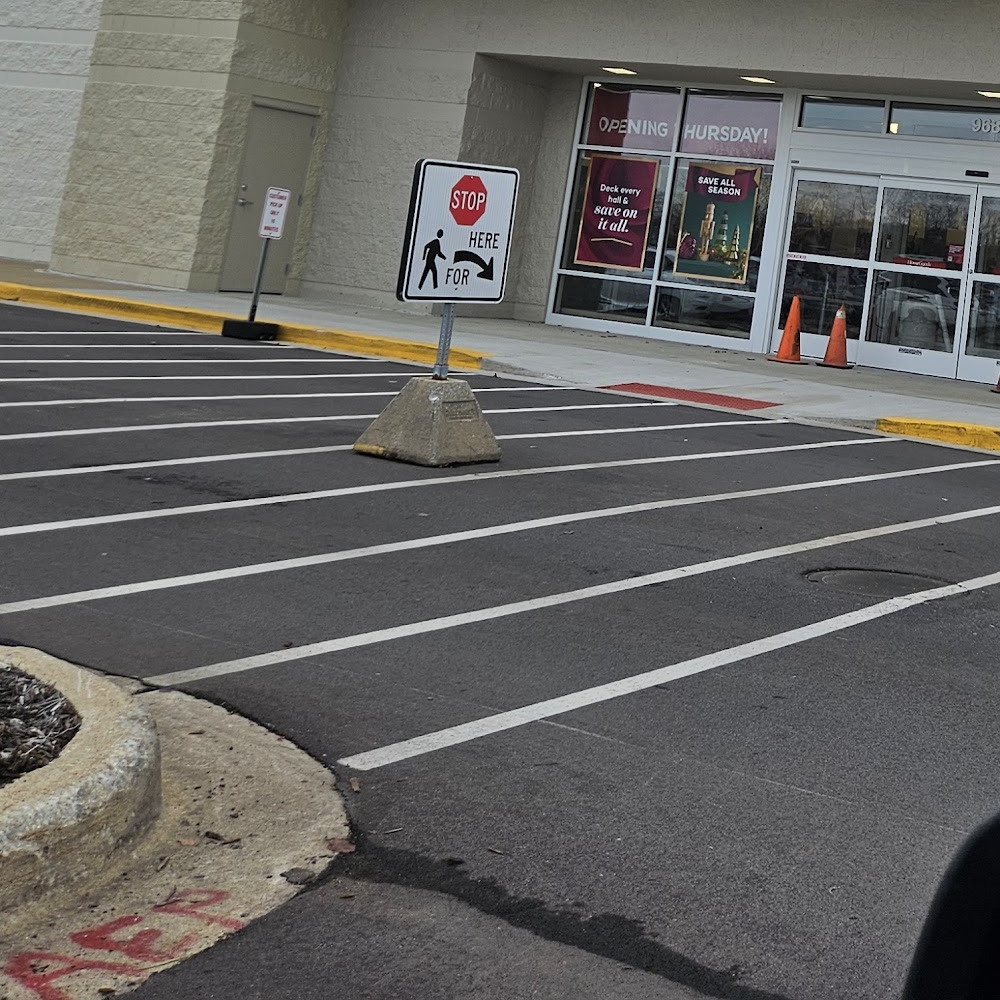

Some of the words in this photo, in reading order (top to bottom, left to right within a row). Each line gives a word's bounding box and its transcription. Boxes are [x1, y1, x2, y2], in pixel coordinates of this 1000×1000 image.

[599, 117, 668, 138] OPENING
[683, 123, 768, 144] HURSDAY!
[698, 176, 719, 186] SAVE
[720, 178, 736, 187] ALL
[600, 183, 619, 193] Deck
[620, 187, 641, 197] every
[707, 186, 741, 196] SEASON
[451, 190, 486, 211] STOP
[607, 194, 621, 204] hall
[622, 196, 629, 205] &
[594, 205, 621, 217] save
[622, 208, 638, 219] on
[597, 217, 609, 230] it
[609, 219, 629, 232] all.
[468, 231, 500, 249] HERE
[445, 268, 470, 286] FOR
